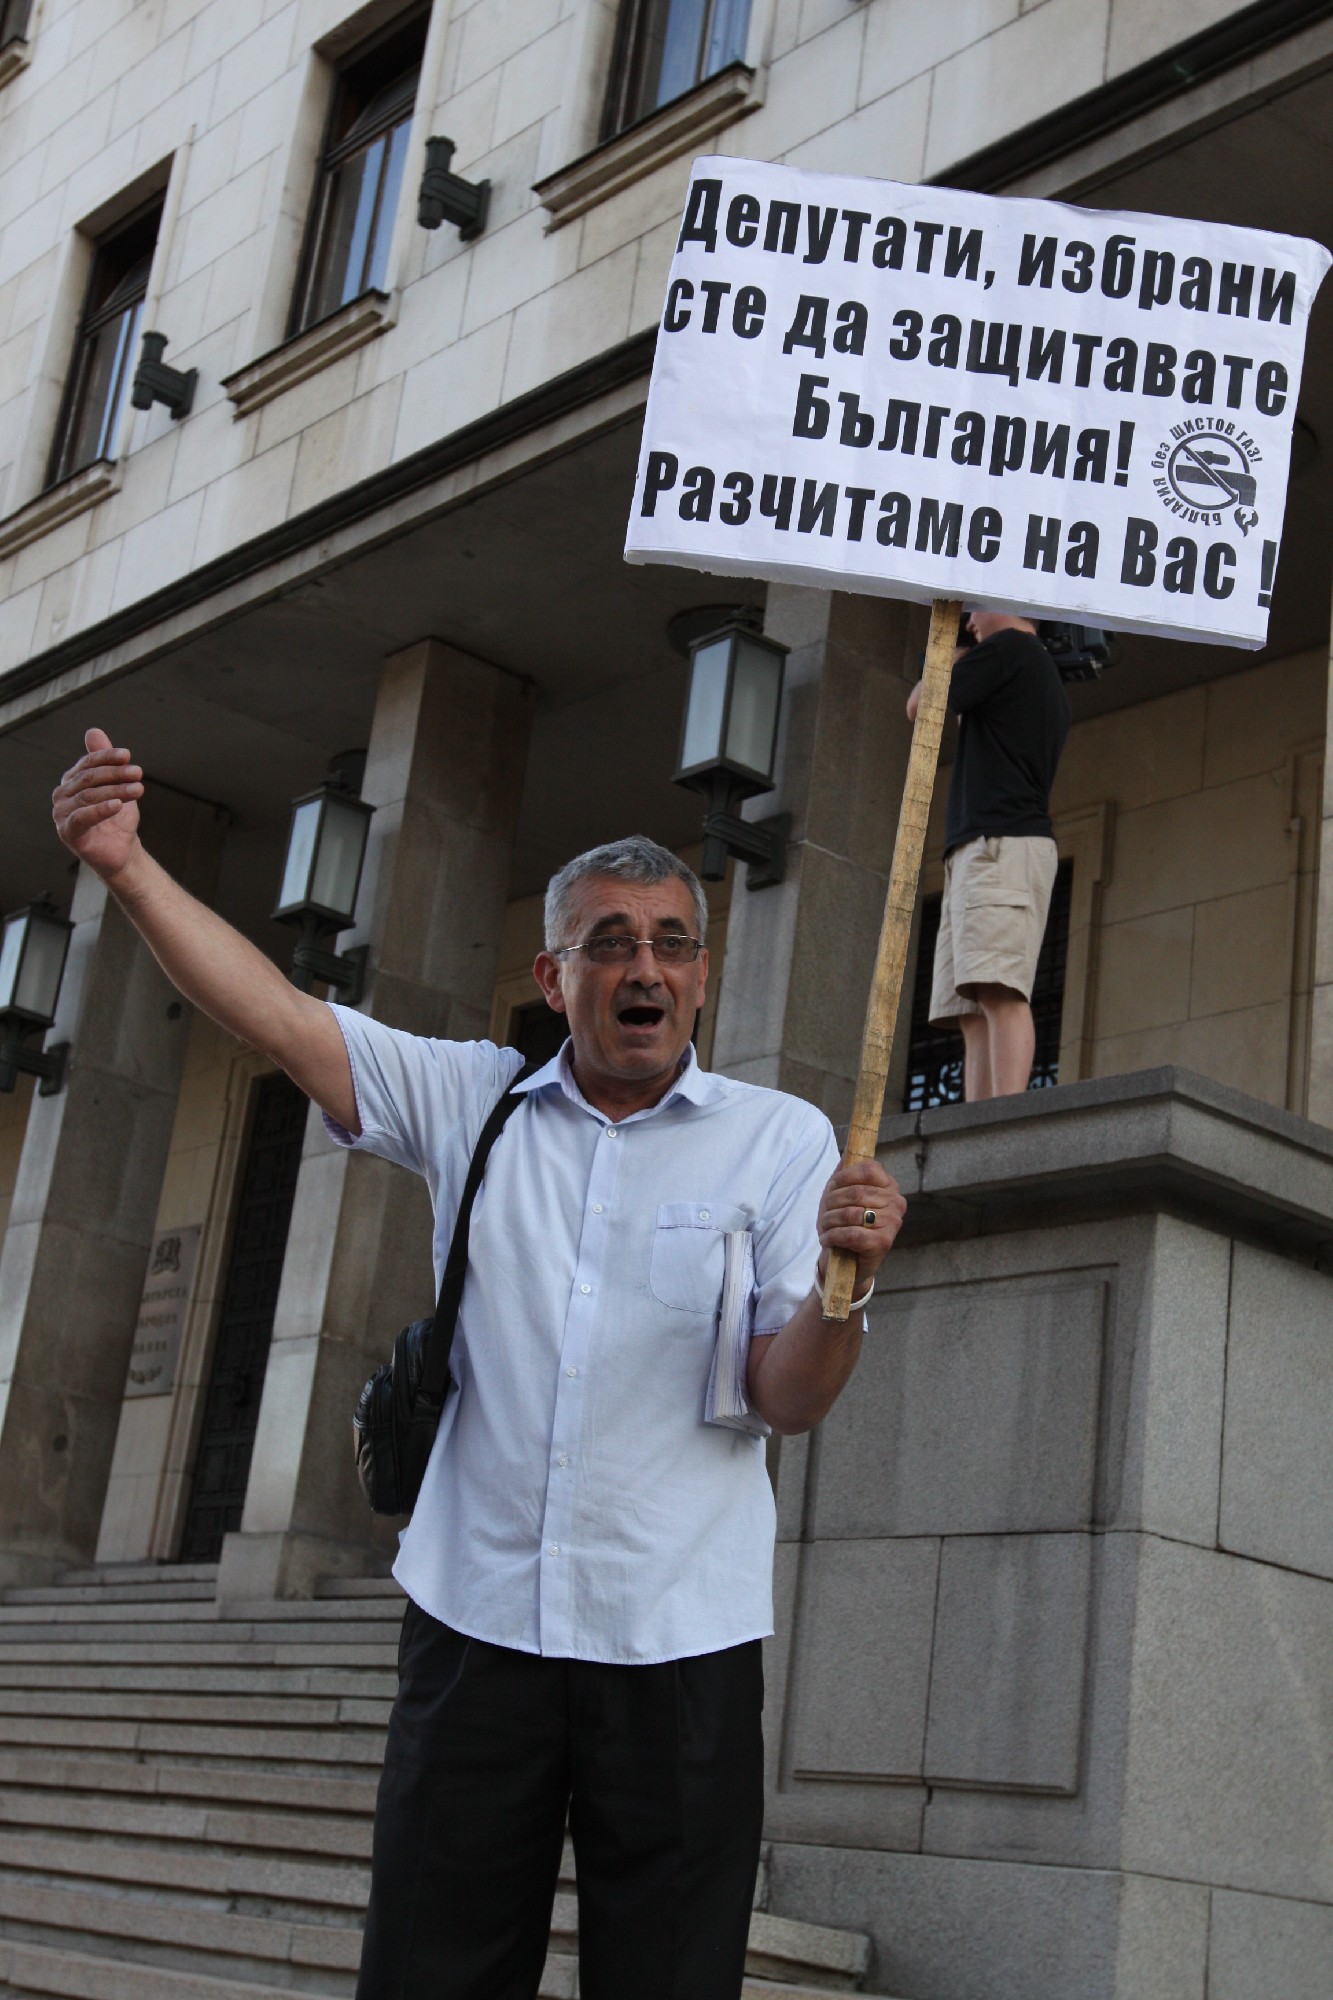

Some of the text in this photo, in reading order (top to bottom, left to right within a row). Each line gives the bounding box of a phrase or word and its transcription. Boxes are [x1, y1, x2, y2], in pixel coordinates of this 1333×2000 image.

[676, 178, 1297, 326] Депутати, избрани
[663, 278, 1289, 417] сте да защитавате
[792, 373, 1136, 488] България!
[1169, 416, 1236, 441] ШИСТОВ
[640, 451, 1003, 563] Разчитаме
[1022, 513, 1100, 580] на
